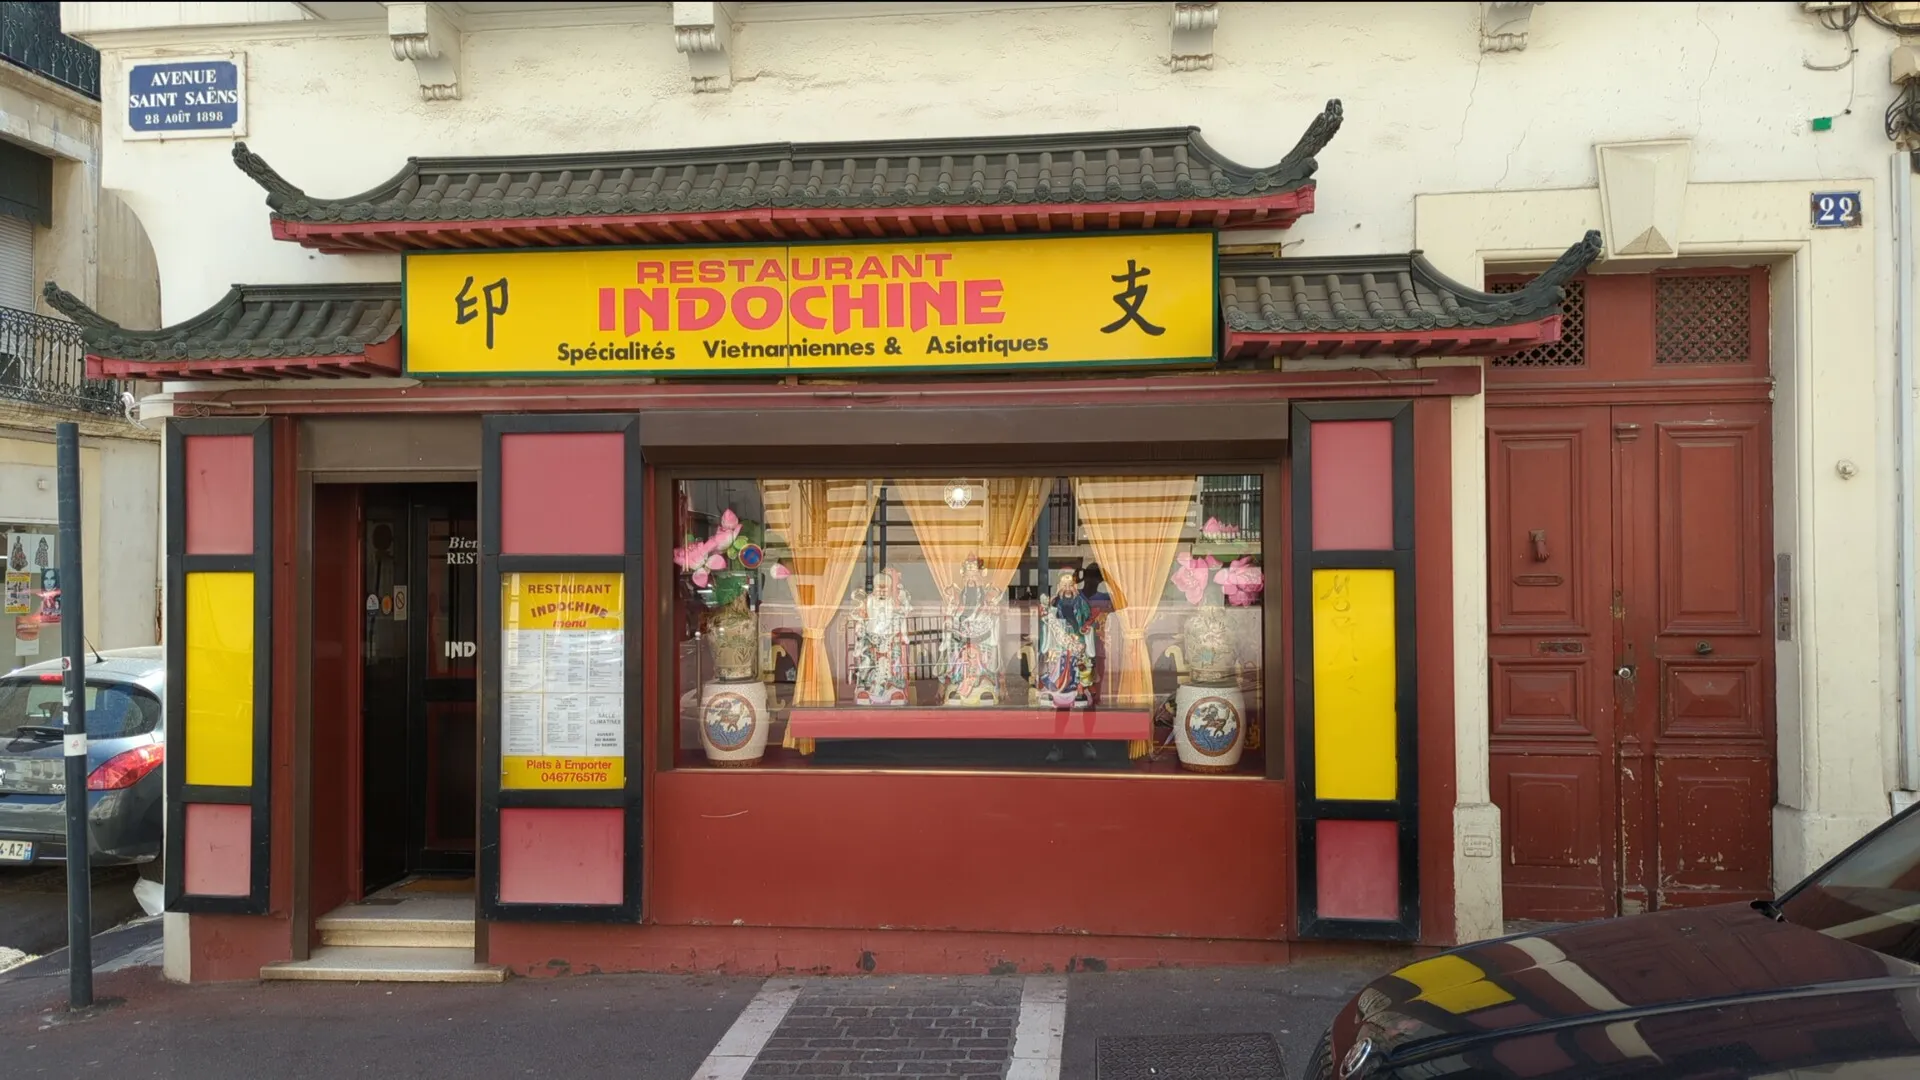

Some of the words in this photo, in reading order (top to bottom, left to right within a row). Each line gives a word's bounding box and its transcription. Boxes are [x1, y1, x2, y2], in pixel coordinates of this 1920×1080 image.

[150, 69, 217, 87] AVENUE
[129, 92, 178, 108] SAINT
[185, 86, 238, 106] SAËNS
[145, 114, 160, 124] 28
[164, 110, 191, 124] AOÛT
[197, 111, 224, 122] 1898
[1819, 197, 1854, 222] 22
[636, 253, 952, 284] RESTAURANT
[1100, 259, 1166, 337] 支
[454, 275, 509, 350] 印
[598, 278, 1007, 338] INDOCHINE
[557, 340, 676, 366] Spécialités
[702, 337, 876, 359] Vietnamiennes
[883, 336, 903, 355] &
[926, 333, 1049, 358] Asiatiques
[528, 584, 612, 594] RESTAURANT
[530, 601, 609, 619] INDOCHINE
[552, 619, 587, 628] menu
[444, 640, 477, 659] IND
[526, 760, 552, 769] Plats
[555, 760, 562, 769] à
[564, 760, 612, 771] Emporter
[541, 772, 608, 783] 0467765176
